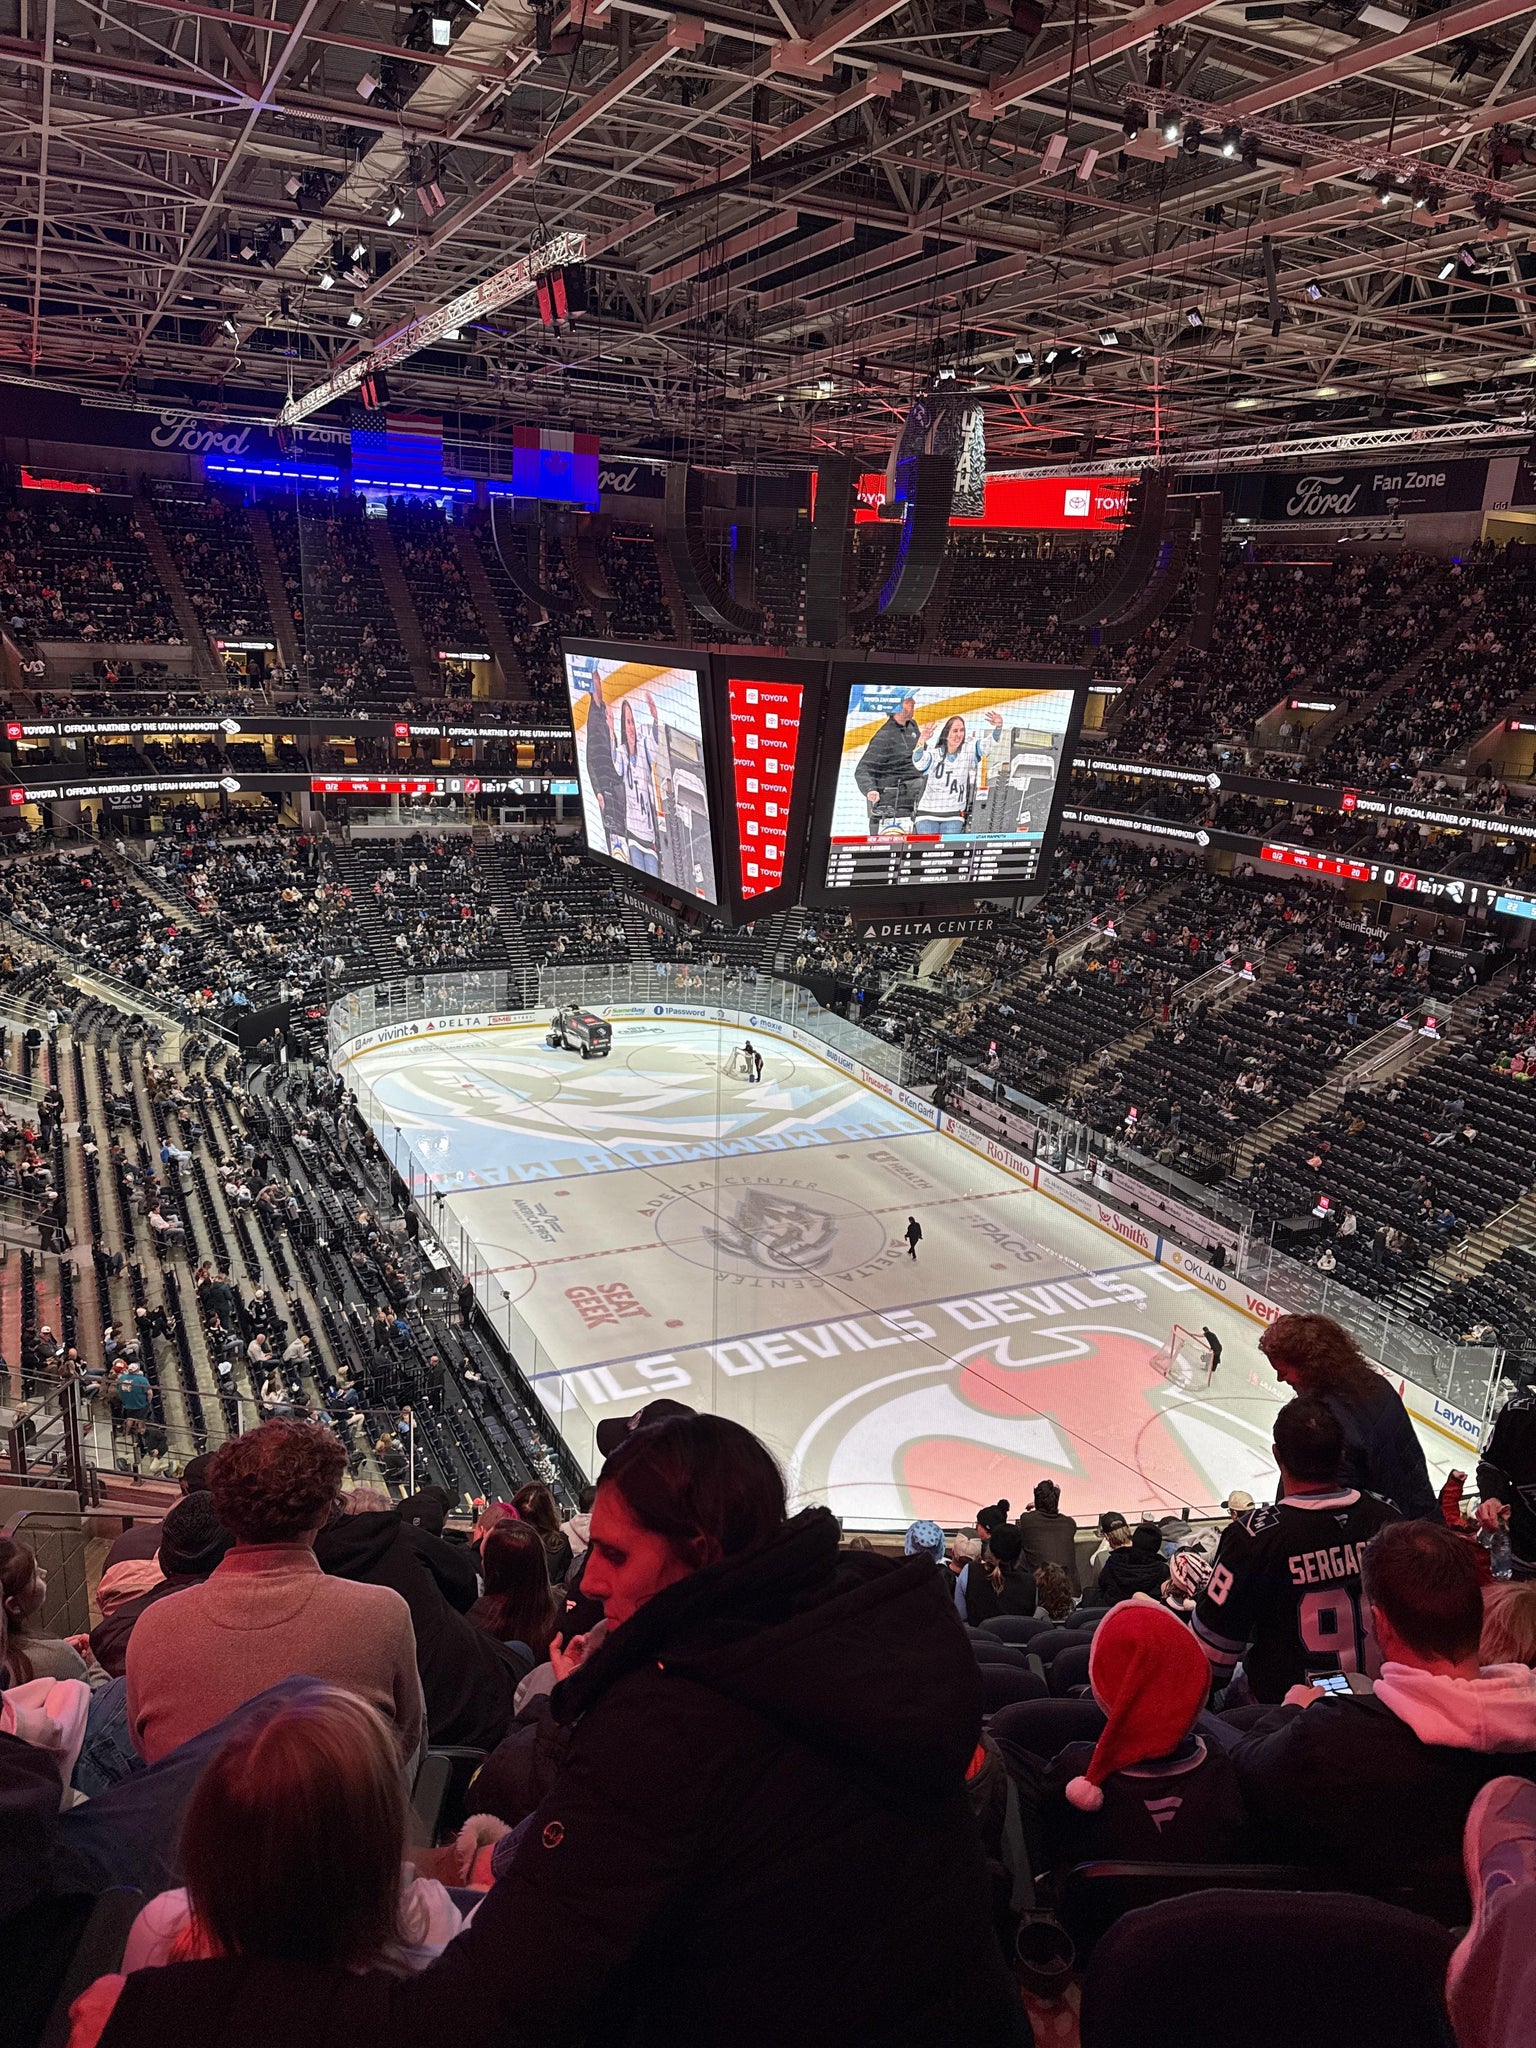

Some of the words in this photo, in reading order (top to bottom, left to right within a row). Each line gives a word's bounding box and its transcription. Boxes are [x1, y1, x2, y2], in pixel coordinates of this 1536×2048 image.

[151, 407, 251, 455] Ford
[307, 431, 352, 446] Zone
[954, 410, 977, 493] UTAH
[598, 467, 639, 493] rd
[1286, 476, 1362, 517] Ford
[1373, 475, 1402, 491] Fan
[1405, 472, 1447, 489] Zone
[760, 693, 788, 703] TOYOTA
[732, 714, 755, 723] OYOTA
[780, 718, 799, 727] TOYO
[23, 726, 56, 735] TOYOTA
[64, 724, 97, 733] OFFICIAL
[97, 723, 131, 732] PARTNER
[131, 723, 143, 731] OF
[143, 723, 157, 731] THE
[158, 723, 178, 731] UTAH
[179, 723, 219, 731] MAMMOTH
[409, 727, 440, 735] TOYOTA
[448, 728, 479, 736] OFFICIAL
[479, 729, 508, 737] PARTNER
[760, 739, 788, 749] TOYOTA
[734, 758, 755, 767] OYOTA
[780, 763, 795, 771] TOY
[1092, 761, 1118, 772] OFFICIAL
[1118, 764, 1143, 774] PARTNER
[1143, 767, 1153, 775] OF
[1152, 769, 1163, 777] THE
[1163, 770, 1178, 779] UTAH
[1177, 772, 1206, 782] MAMMOTH
[25, 790, 58, 800] TOYOTA
[66, 786, 98, 797] OFFICIAL
[98, 785, 131, 795] PARTNER
[131, 784, 143, 793] OF
[143, 783, 157, 792] THE
[158, 782, 178, 791] UTAH
[179, 781, 219, 791] MAMMOTH
[325, 783, 339, 791] 0/2
[451, 780, 460, 792] 0
[482, 783, 507, 792] 12:17
[529, 780, 536, 792] 1
[760, 783, 787, 793] TOYOTA
[935, 762, 966, 803] UTAH
[737, 802, 755, 811] YOTA
[1084, 814, 1109, 825] OFFICIAL
[1109, 818, 1134, 828] PARTNER
[1134, 820, 1143, 829] OF
[1142, 823, 1153, 832] THE
[1152, 824, 1167, 834] UTAH
[1167, 827, 1196, 839] MAMMOTH
[1356, 799, 1386, 813] TOYOTA
[1394, 806, 1425, 820] OFFICIAL
[1425, 811, 1459, 826] PARTNER
[1458, 816, 1471, 827] OF
[1471, 819, 1487, 831] THE
[1487, 821, 1509, 834] UTAH
[1509, 825, 1536, 838] MAMM
[760, 826, 787, 837] TOYOTA
[760, 868, 782, 878] TOYOT
[1272, 852, 1283, 860] 0/2
[1351, 868, 1361, 877] 20
[1384, 869, 1395, 885] 0
[1417, 879, 1445, 897] 12:17
[1471, 887, 1479, 903] 1
[629, 895, 650, 915] DELTA
[650, 906, 675, 928] CENTER
[1507, 902, 1519, 911] 22
[881, 923, 932, 936] DELTA
[938, 919, 994, 933] CENTER
[665, 1007, 706, 1018] 1Password
[439, 1017, 481, 1028] DELTA
[760, 1019, 783, 1031] moxie
[378, 1025, 409, 1043] vivint
[826, 1050, 838, 1062] BUD
[838, 1055, 854, 1071] LIGHT
[904, 1095, 918, 1110] Ken
[917, 1102, 935, 1120] Garff
[648, 1181, 714, 1208] DELTA
[726, 1177, 818, 1190] CENTER
[532, 1224, 557, 1243] FIRST
[1113, 1214, 1149, 1249] Smith's
[973, 1221, 1043, 1263] PACS
[1184, 1259, 1227, 1291] OKLAND
[564, 1286, 620, 1330] GEEK
[596, 1282, 652, 1318] SEAT
[938, 1272, 1147, 1335] DEVILS
[1246, 1294, 1281, 1321] veri
[709, 1310, 936, 1377] DEVILS
[536, 1356, 692, 1413] VILS
[1433, 1400, 1481, 1438] Layton
[1254, 1510, 1271, 1529] TAH
